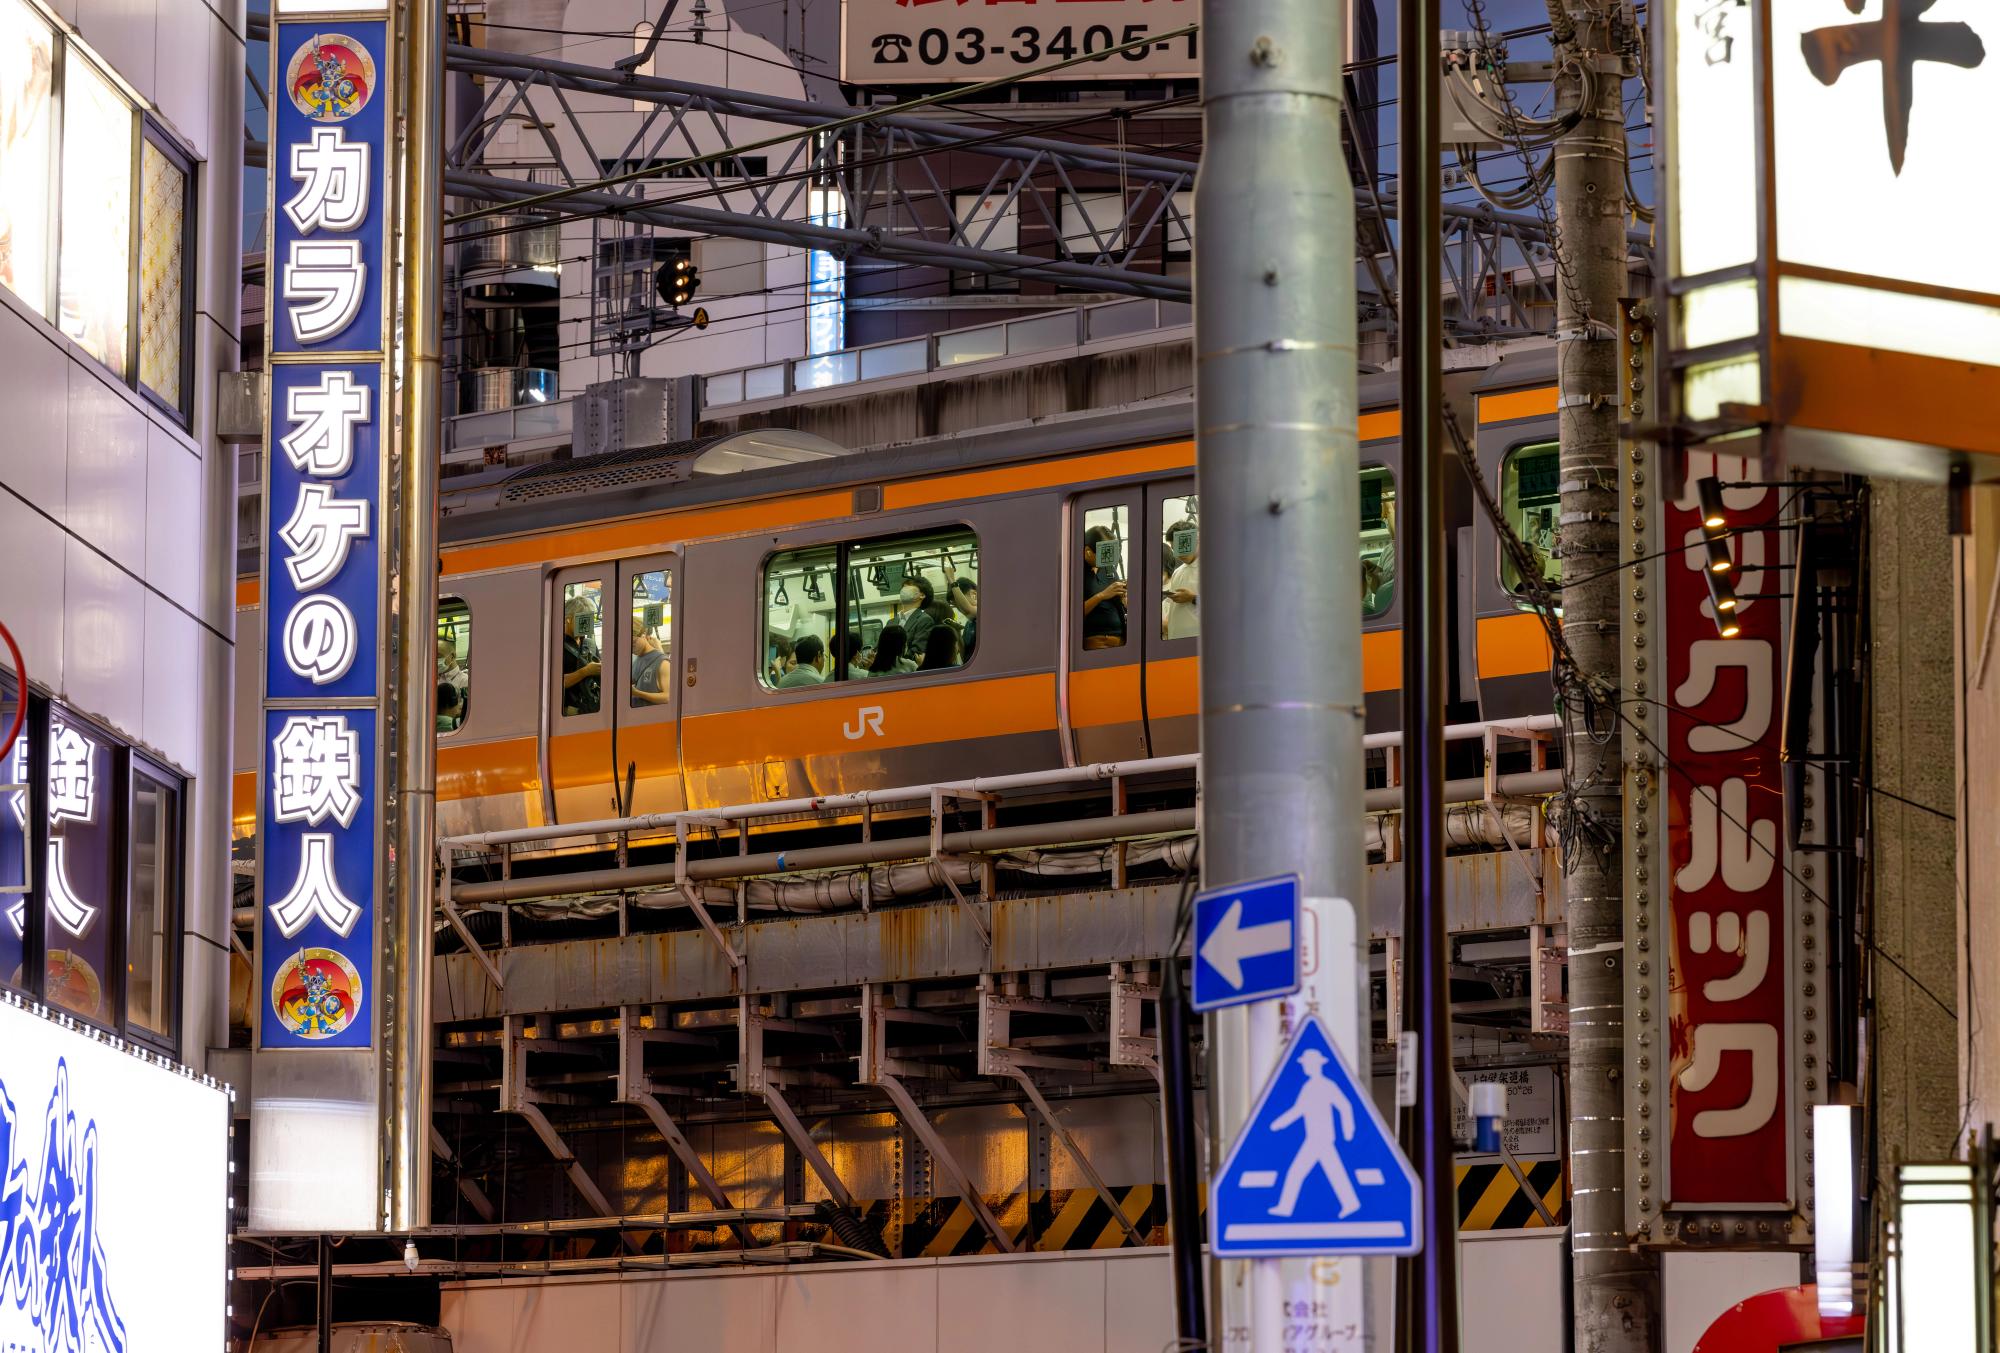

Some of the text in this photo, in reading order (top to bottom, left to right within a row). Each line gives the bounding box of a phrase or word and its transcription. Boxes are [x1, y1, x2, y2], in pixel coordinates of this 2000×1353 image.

[268, 127, 371, 939] カラオケの鉄人
[843, 706, 885, 740] JR
